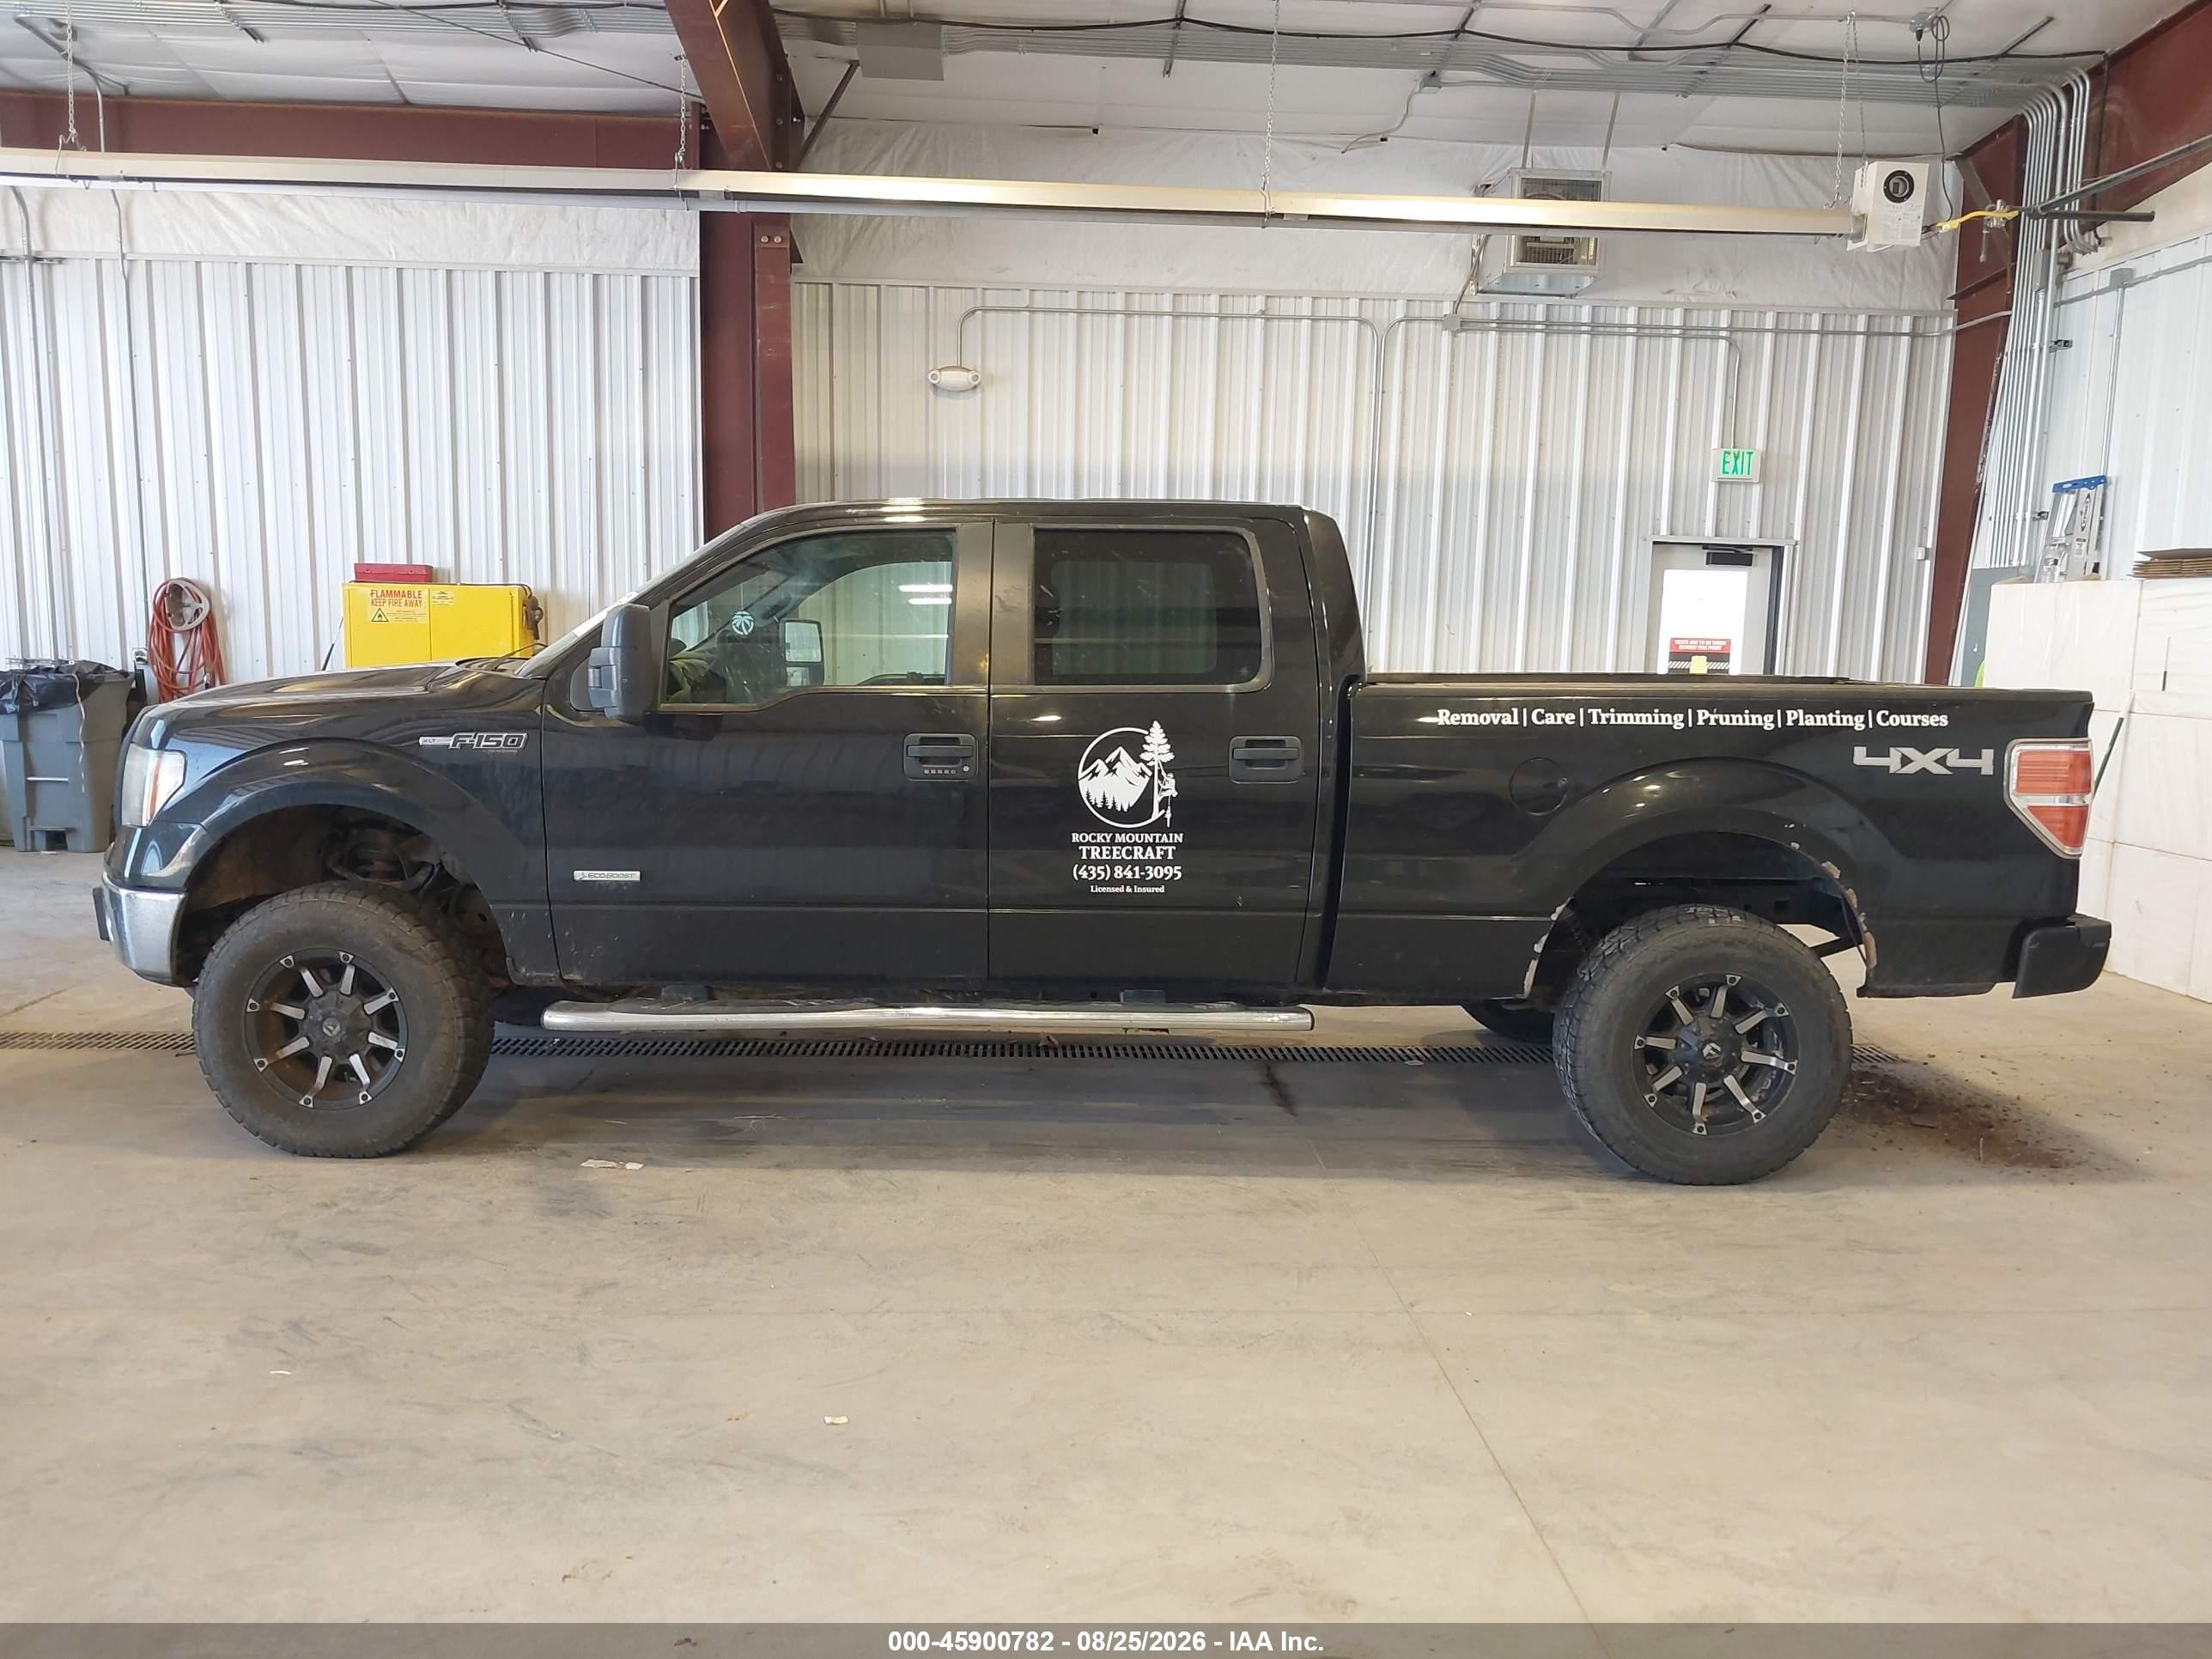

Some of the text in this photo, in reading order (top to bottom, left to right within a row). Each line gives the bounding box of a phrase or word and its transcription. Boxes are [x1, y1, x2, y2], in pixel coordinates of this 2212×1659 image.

[1722, 450, 1754, 476] EXIT
[370, 589, 423, 599] FLAMMABLE
[371, 598, 386, 607] KEEP
[388, 599, 403, 607] FIRE
[404, 599, 423, 608] AWAY
[1437, 708, 1519, 726] Removal
[1531, 708, 1576, 726] Care
[1588, 708, 1685, 729] Trimming
[1696, 708, 1775, 730] Pruning
[1785, 708, 1865, 730] Planting
[1876, 709, 1948, 727] Courses
[449, 732, 528, 750] F-150
[1853, 745, 1994, 776] 4X4
[1072, 833, 1184, 843] ROCKY MOUNTAIN
[1079, 845, 1176, 860] TREECRAFT
[1073, 864, 1182, 881] (435) 841-3095
[1090, 884, 1165, 893] Licensed & Insured
